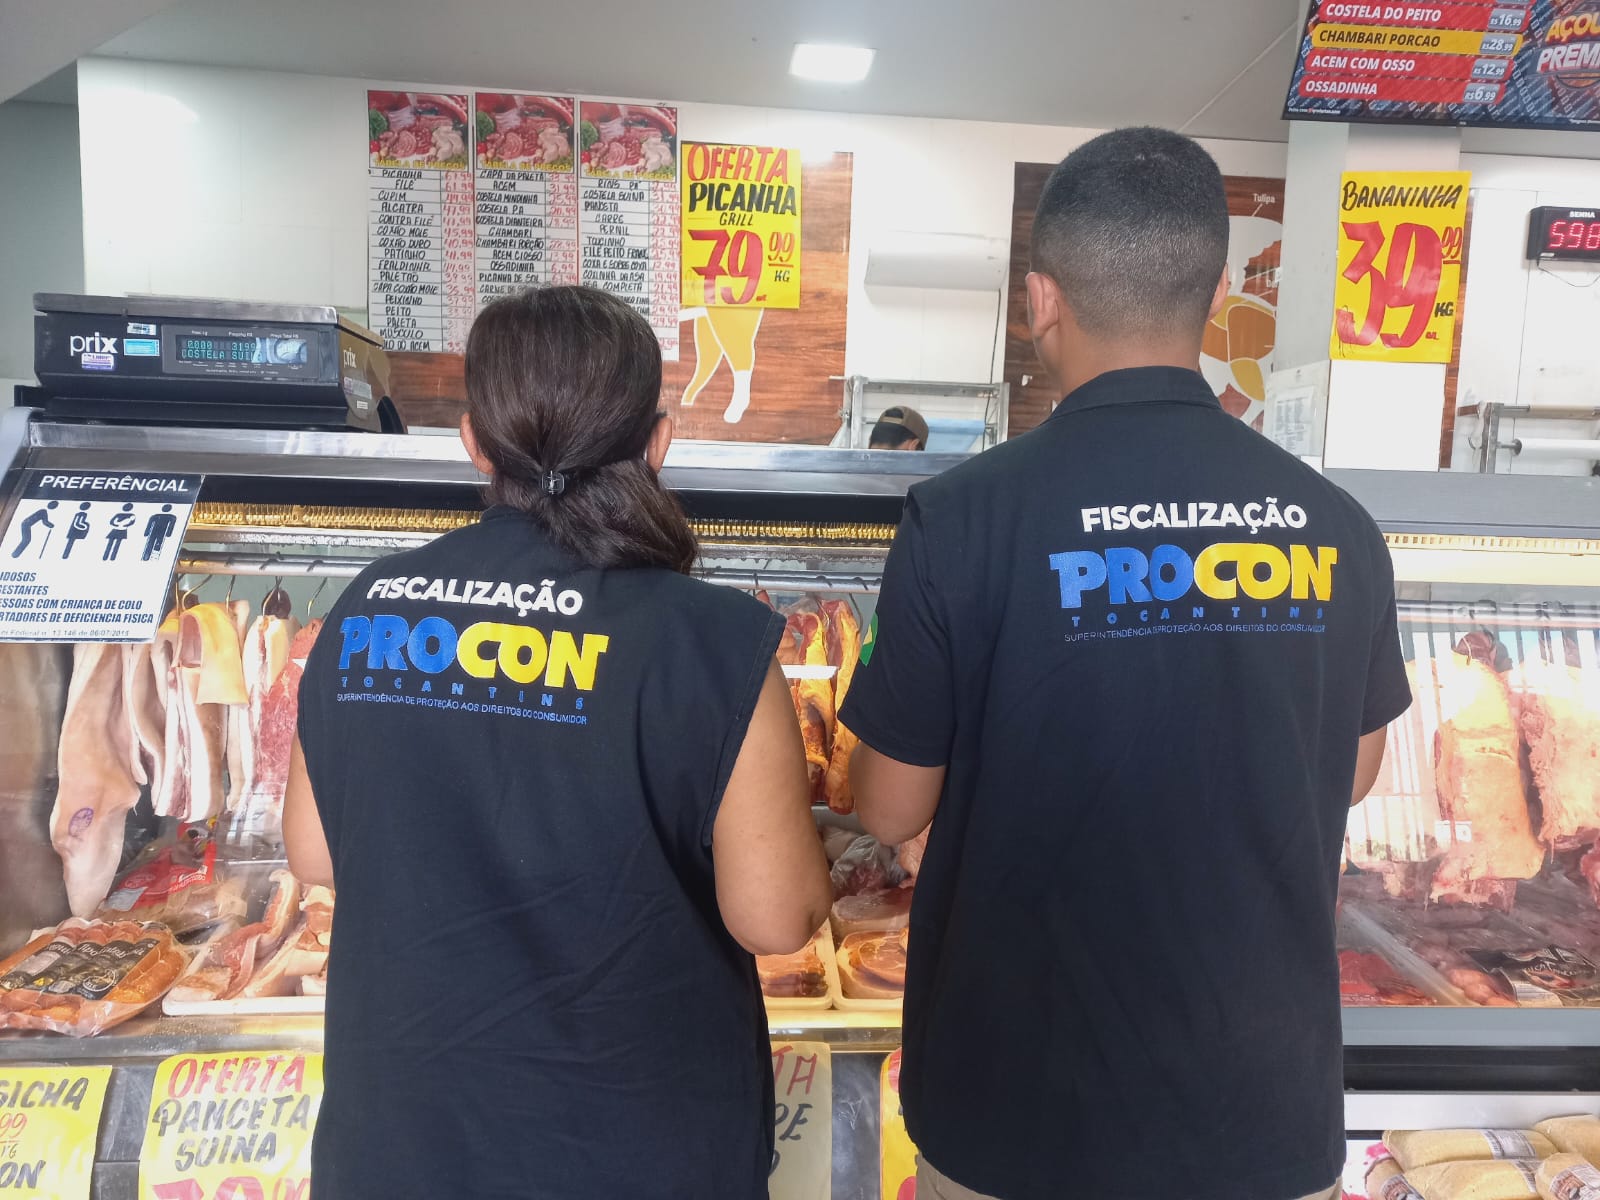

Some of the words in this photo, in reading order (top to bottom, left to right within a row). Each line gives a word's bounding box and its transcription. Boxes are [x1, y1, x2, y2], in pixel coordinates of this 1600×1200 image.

[1326, 4, 1381, 19] COSTELA
[1383, 8, 1403, 20] DO
[1405, 9, 1441, 22] PEITO
[1319, 30, 1388, 44] CHAMBARI
[1389, 34, 1440, 47] PORCAO
[1311, 55, 1347, 68] ACEM
[1350, 57, 1379, 70] COM
[1382, 59, 1415, 71] OSSO
[1305, 81, 1377, 95] OSSADINHA
[688, 144, 788, 184] OFERTA
[382, 170, 422, 180] PICANHA
[480, 170, 503, 179] CAPA
[517, 172, 544, 181] PALETA
[493, 181, 516, 191] ACEM
[378, 190, 406, 201] CUPIM
[476, 192, 501, 202] COSTELA
[583, 190, 615, 200] COSTELA
[688, 182, 797, 216] PICANHA
[1253, 193, 1276, 204] Tulipa
[1342, 180, 1463, 211] BANANINHA
[381, 202, 424, 213] ALCATRA
[477, 203, 508, 214] COSTELA
[584, 201, 618, 211] PANCETA
[379, 214, 412, 225] CONTRA
[476, 216, 504, 226] COSTELA
[506, 217, 543, 228] DIANTEIRA
[719, 212, 753, 226] GRILL
[409, 228, 428, 238] MOLE
[488, 227, 533, 238] CHAMBARI
[600, 224, 630, 236] PERNIL
[408, 239, 431, 249] DURO
[475, 237, 517, 248] CHAMBARI
[384, 249, 426, 260] PATINHO
[493, 250, 512, 259] ACEM
[378, 261, 431, 272] FRALDINHA
[490, 261, 534, 272] OSSADINHA
[688, 229, 764, 304] 79
[768, 232, 795, 263] 99
[480, 273, 512, 282] PICANHA
[583, 270, 616, 280] COXINHA
[774, 270, 790, 282] KG
[419, 285, 439, 295] MOLE
[603, 281, 642, 292] COMPLETA
[1336, 221, 1442, 348] 39
[386, 306, 411, 316] PEITO
[1434, 302, 1453, 317] KG
[387, 317, 417, 328] PALETA
[70, 332, 118, 356] prix
[39, 475, 189, 492] PREFERÊNCIAL
[1080, 497, 1307, 535] FISCALIZAÇÃO
[0, 571, 37, 583] IDOSOS
[1049, 542, 1338, 608] PROCON
[367, 576, 583, 617] FISCALIZAÇÃO
[36, 599, 58, 609] COM
[104, 600, 118, 610] DE
[118, 600, 143, 610] COLO
[49, 612, 62, 622] DE
[63, 612, 121, 623] DEFICIENCIA
[123, 613, 154, 623] FISICA
[1072, 607, 1323, 627] TOCANTINS
[1064, 629, 1152, 642] SUPERINTENDÊNCIA
[1202, 624, 1223, 632] AOS
[1225, 623, 1264, 632] DIREITOS
[1265, 624, 1278, 632] DO
[338, 614, 610, 691] PROCON
[341, 676, 583, 709] TOCANTINS
[337, 693, 404, 704] SUPERINTENDÊNCIA
[405, 696, 416, 705] DE
[416, 697, 459, 711] PROTEÇÃO
[461, 701, 479, 713] AOS
[481, 704, 521, 718] DIREITOS
[533, 710, 588, 726] CONSUMIDOR
[168, 1055, 305, 1100] OFERTA
[152, 1094, 311, 1137] PANCETA
[175, 1131, 277, 1172] SUINA
